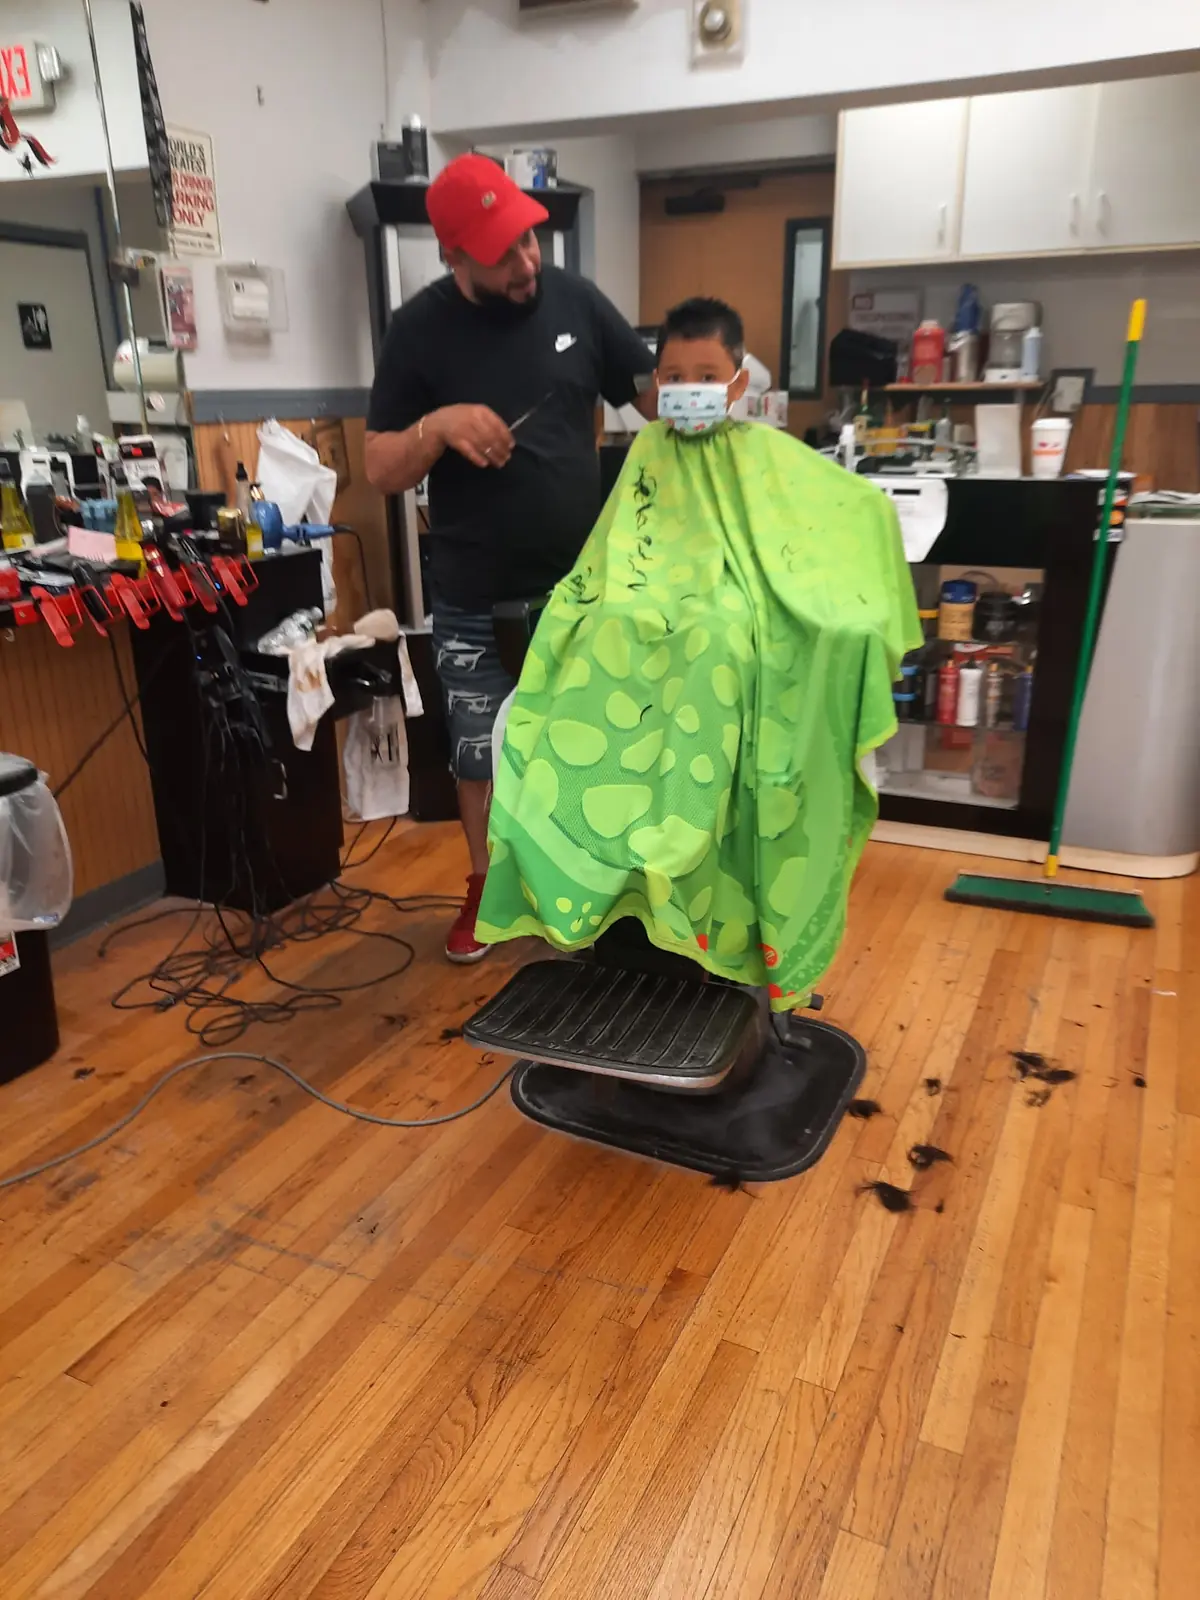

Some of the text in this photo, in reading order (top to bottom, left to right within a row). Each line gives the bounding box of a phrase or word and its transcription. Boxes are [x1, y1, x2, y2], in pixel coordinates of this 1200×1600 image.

[169, 138, 205, 159] ORLD'S
[170, 155, 206, 175] REATEST
[171, 189, 214, 212] ARKING
